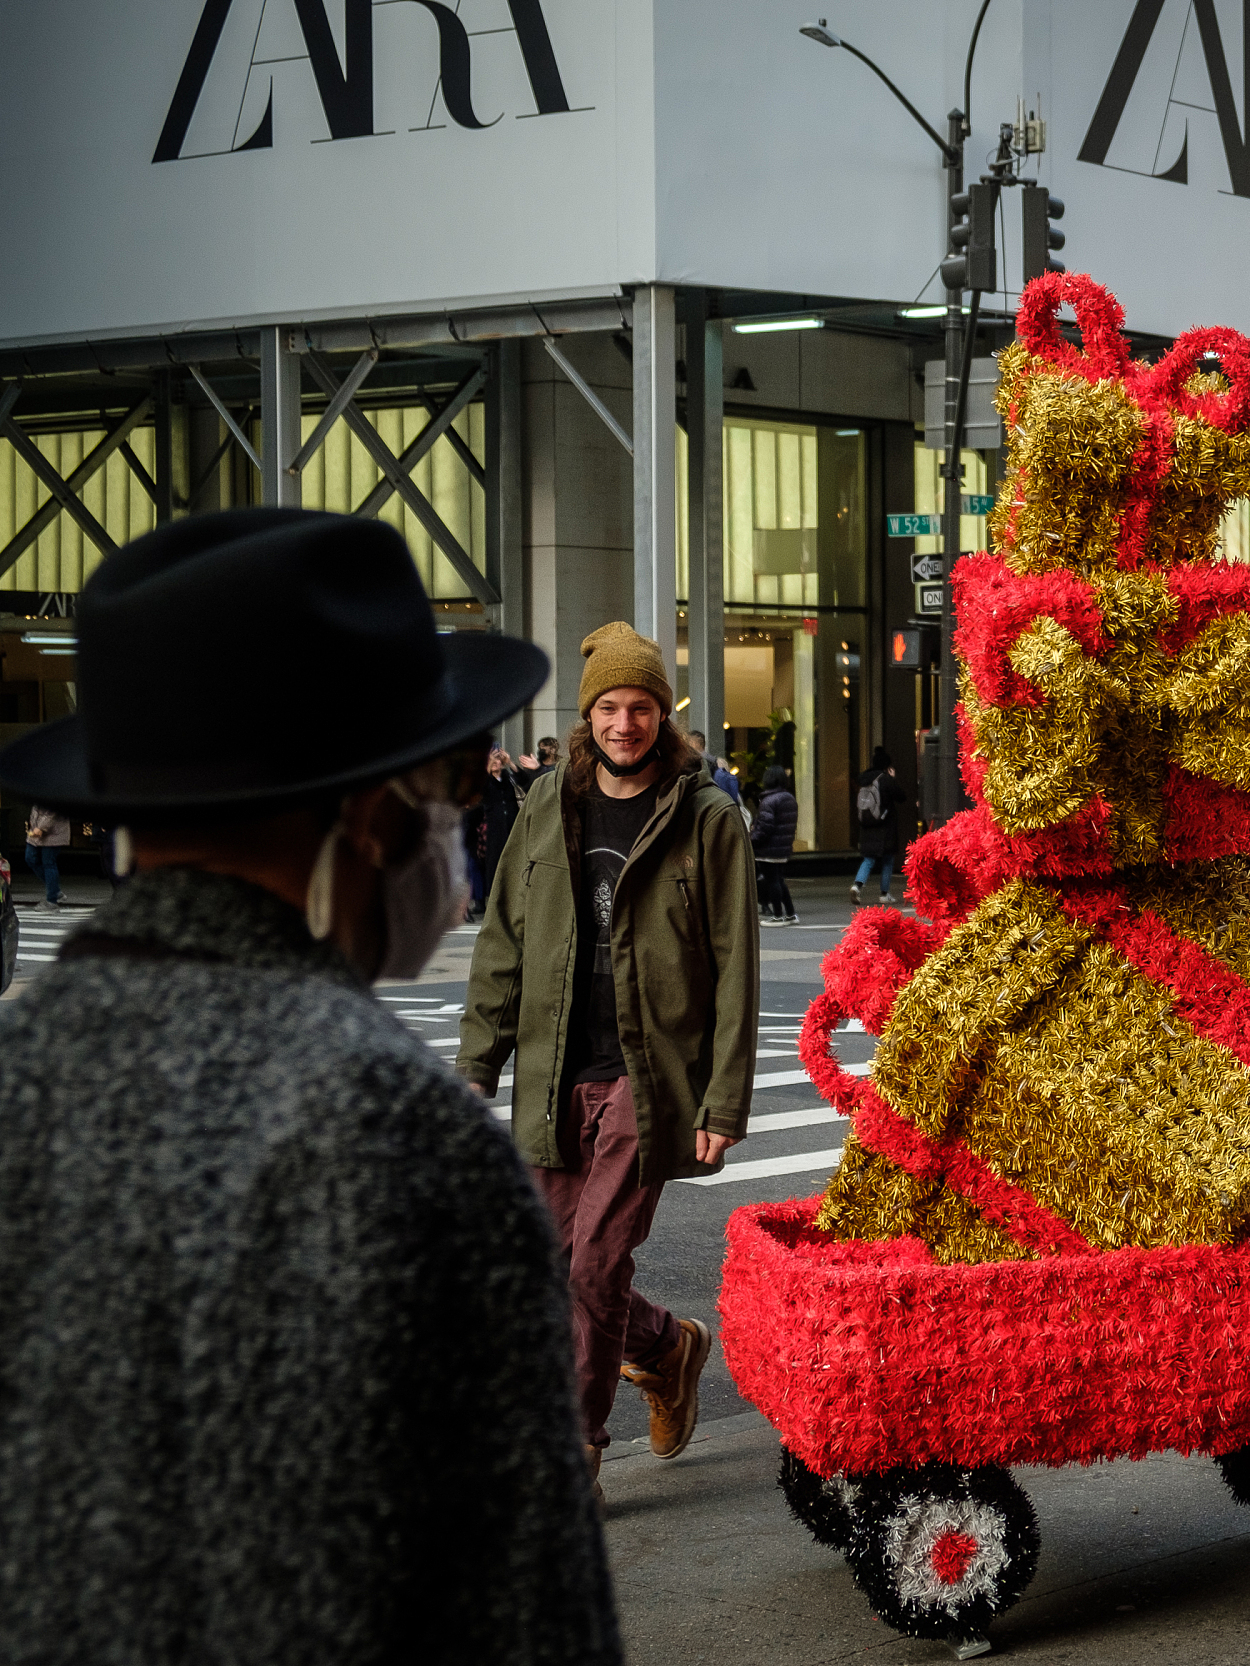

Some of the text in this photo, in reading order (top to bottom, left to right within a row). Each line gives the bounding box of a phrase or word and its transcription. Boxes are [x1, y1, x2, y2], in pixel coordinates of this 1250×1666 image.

[889, 517, 900, 534] W
[904, 517, 920, 534] 52
[920, 562, 940, 574] ONE
[926, 593, 942, 604] ON
